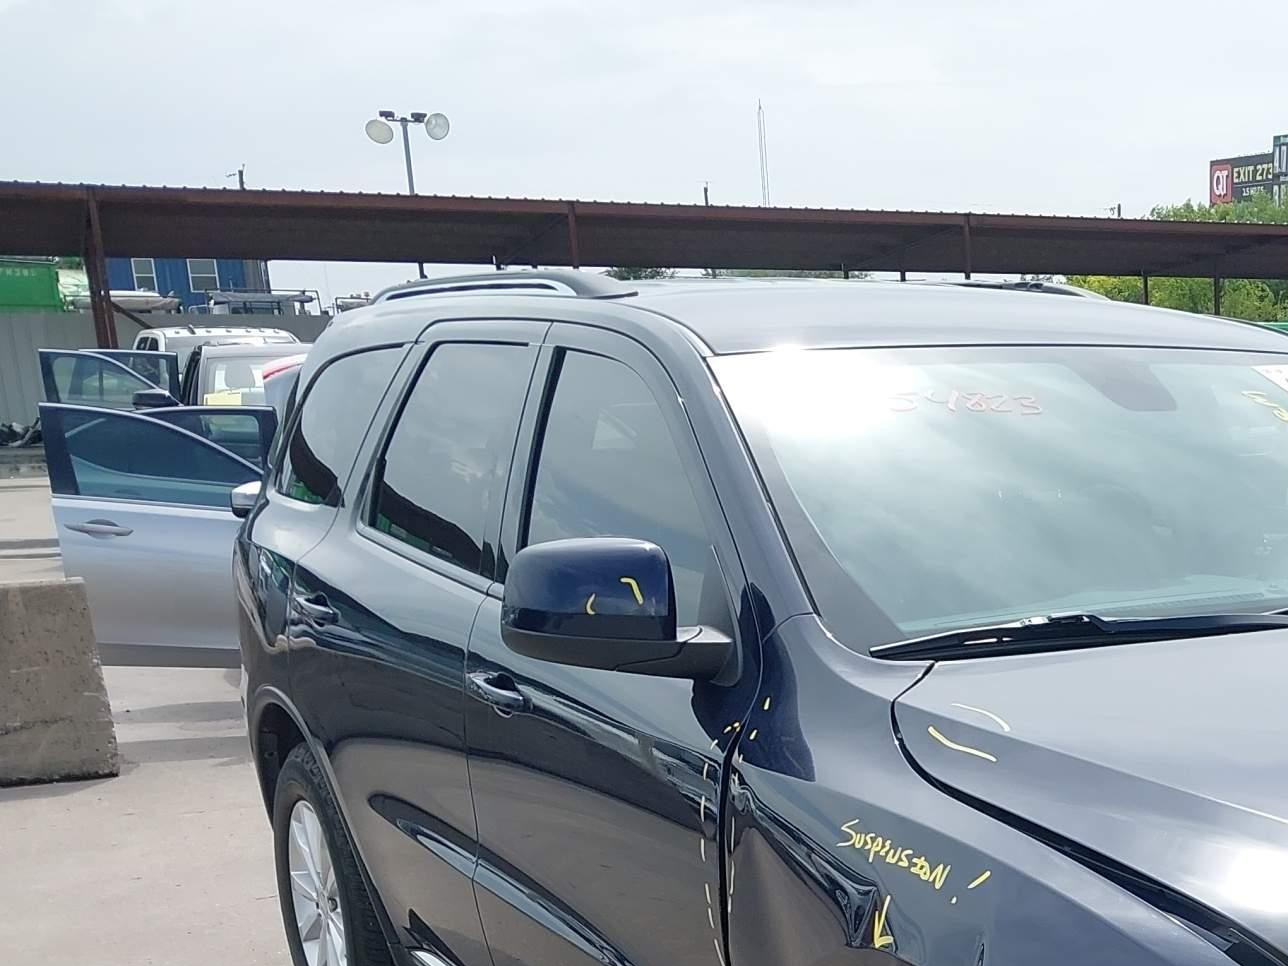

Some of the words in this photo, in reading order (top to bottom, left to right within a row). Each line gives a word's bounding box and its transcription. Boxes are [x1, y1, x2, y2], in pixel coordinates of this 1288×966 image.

[1213, 170, 1228, 198] QT
[1233, 165, 1255, 183] EXIT
[1255, 163, 1273, 181] 273
